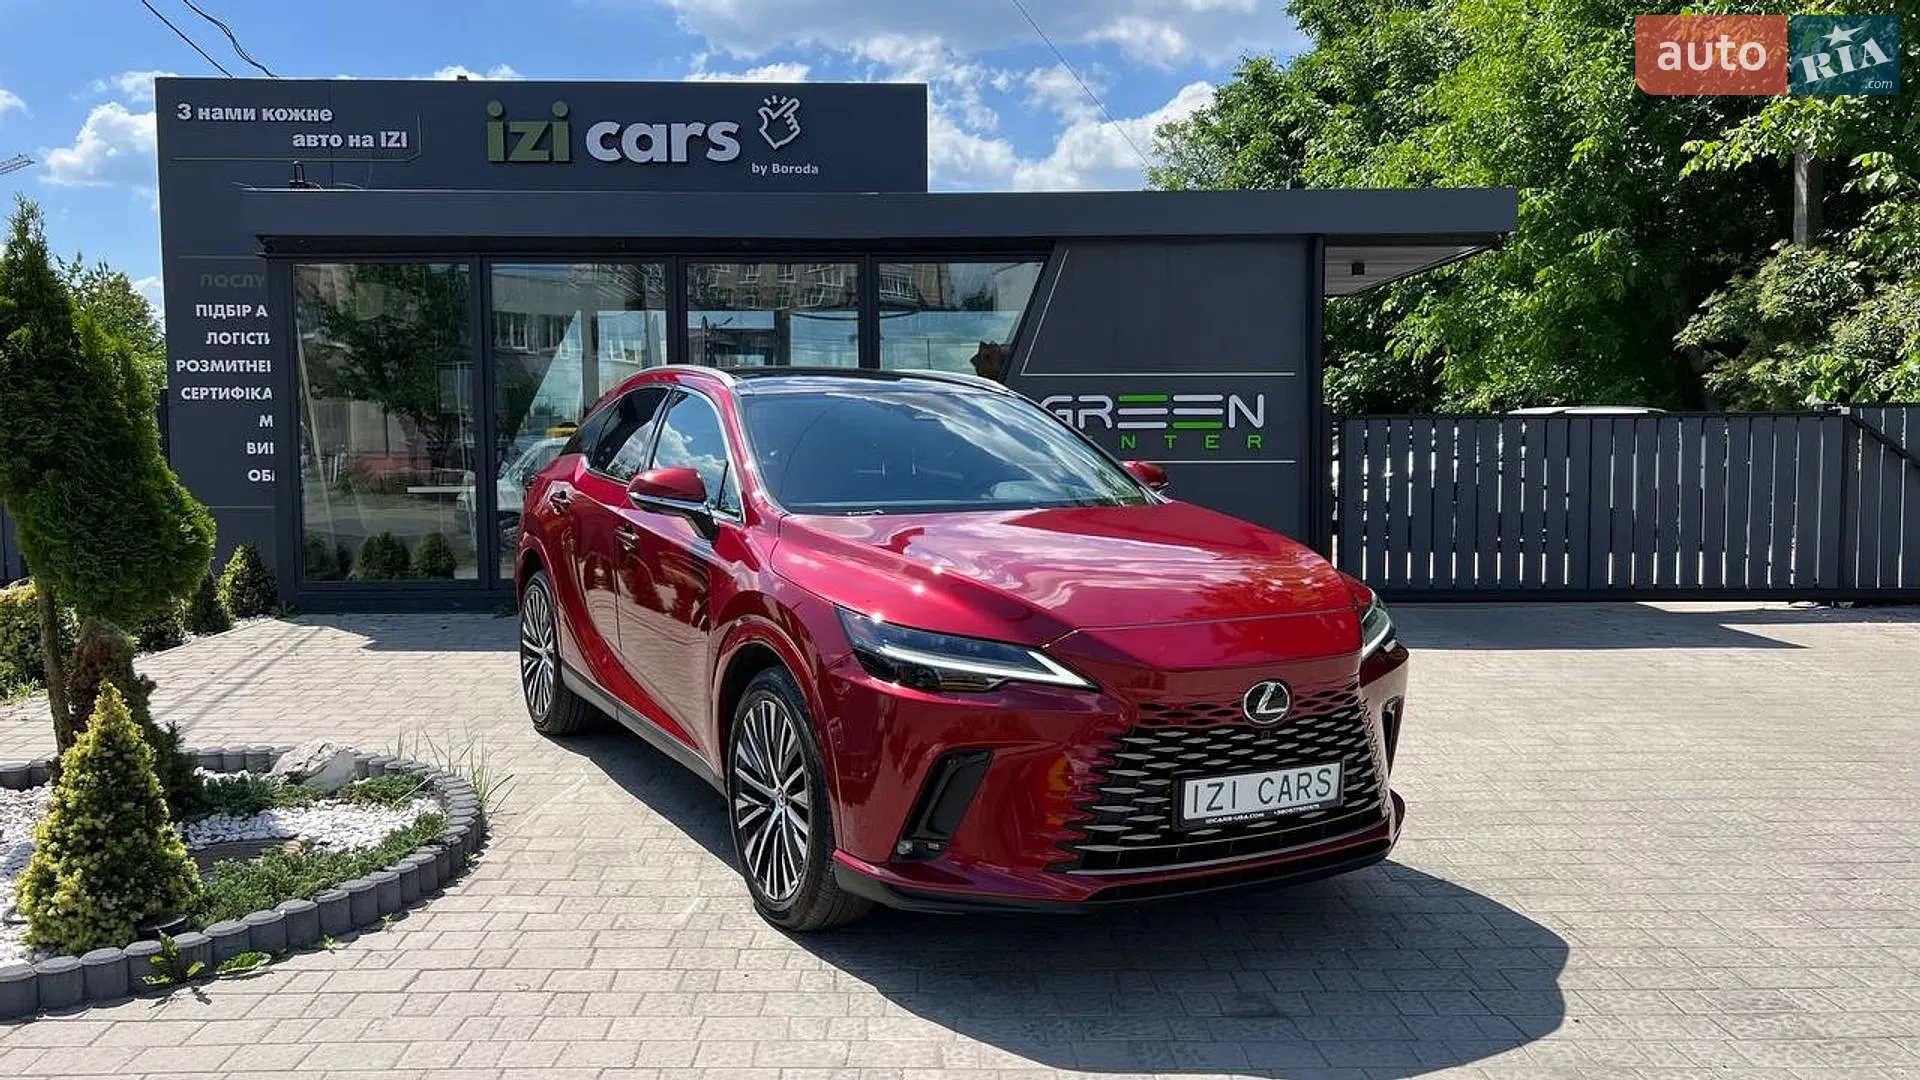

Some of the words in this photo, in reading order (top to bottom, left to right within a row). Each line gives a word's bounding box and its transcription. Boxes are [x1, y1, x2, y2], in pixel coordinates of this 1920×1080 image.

[198, 106, 256, 121] нами
[262, 106, 333, 122] кожне
[292, 133, 343, 148] авто
[349, 133, 374, 148] на
[380, 131, 408, 149] IZI
[487, 101, 570, 162] izi
[586, 121, 741, 163] cars
[752, 163, 768, 176] by
[772, 163, 819, 175] Boroda
[196, 305, 251, 319] ПІДБІР
[1040, 394, 1265, 429] GREEN
[248, 470, 275, 482] ОБ
[1193, 780, 1236, 813] IZI
[1258, 768, 1332, 805] CARS
